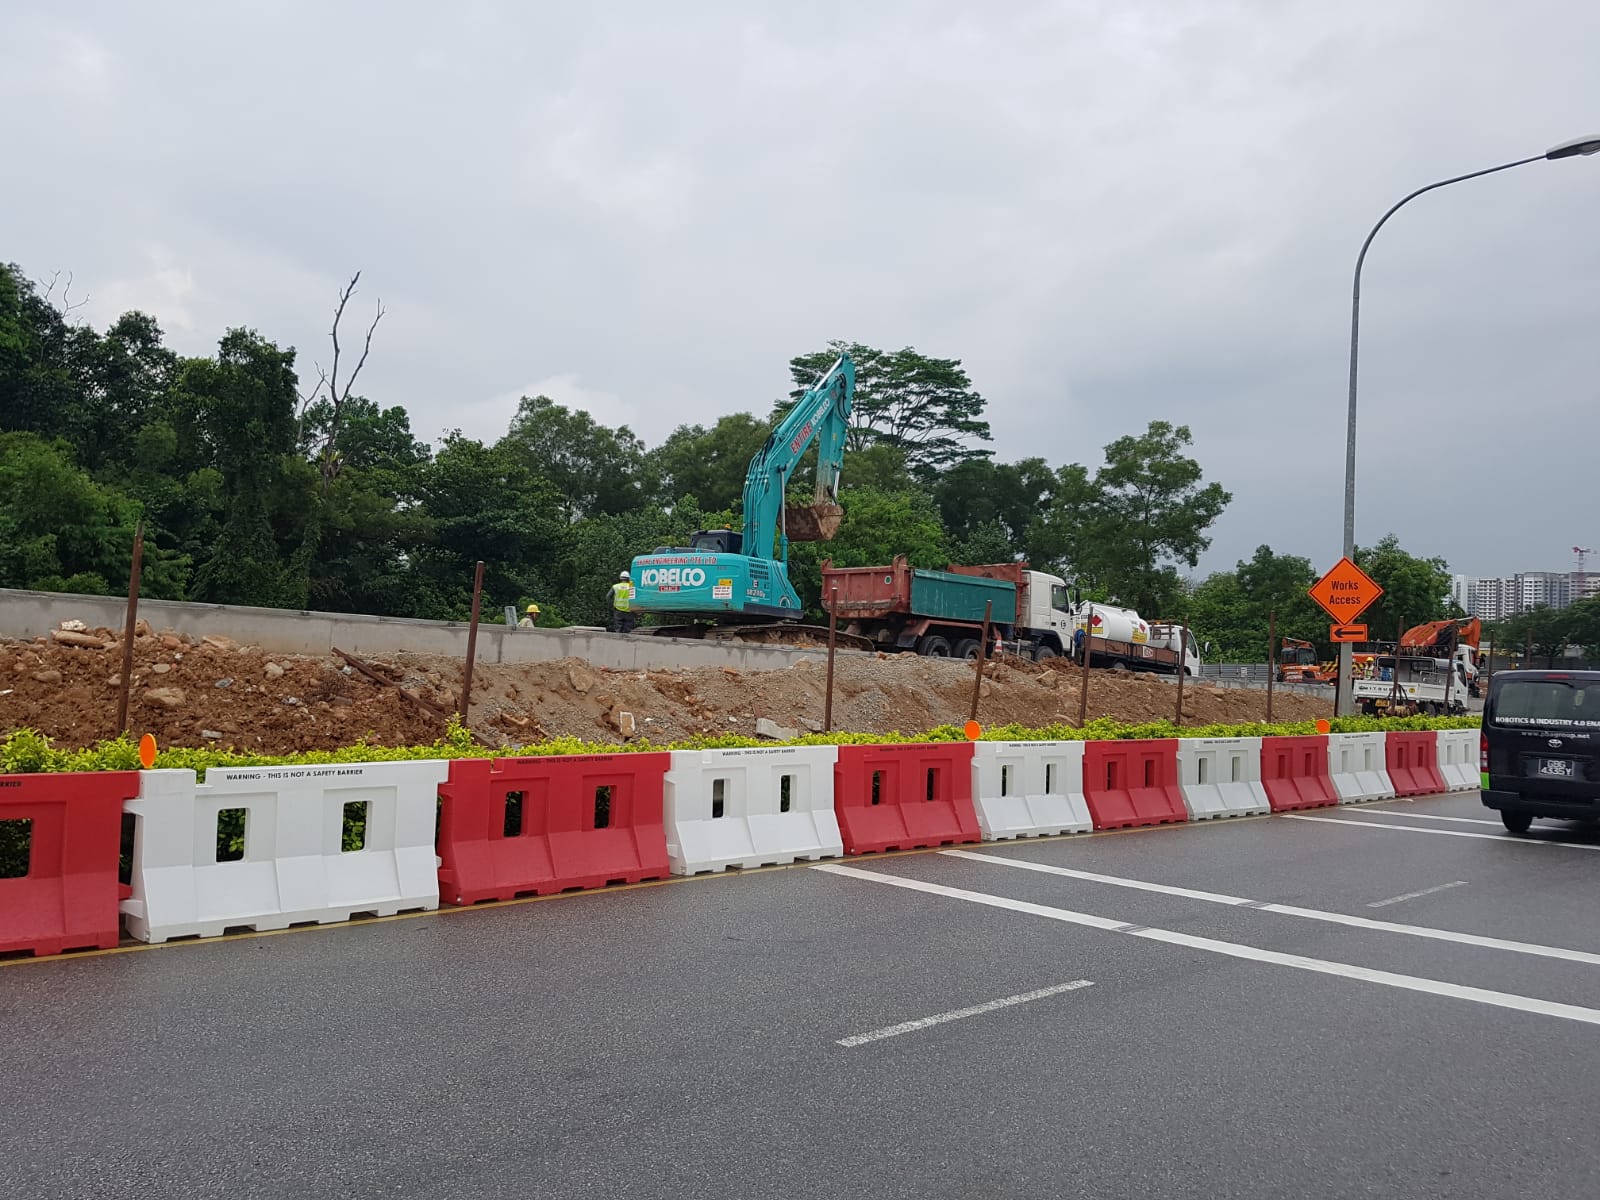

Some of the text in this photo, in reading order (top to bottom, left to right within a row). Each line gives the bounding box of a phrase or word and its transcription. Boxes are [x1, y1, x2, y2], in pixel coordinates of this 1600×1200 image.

[790, 420, 813, 455] ENTIRE
[641, 567, 706, 587] KOBELCO
[1331, 580, 1359, 590] Works
[1329, 594, 1361, 605] Access
[1495, 716, 1529, 724] ROBOTICS
[1536, 718, 1573, 726] INDUSTRY
